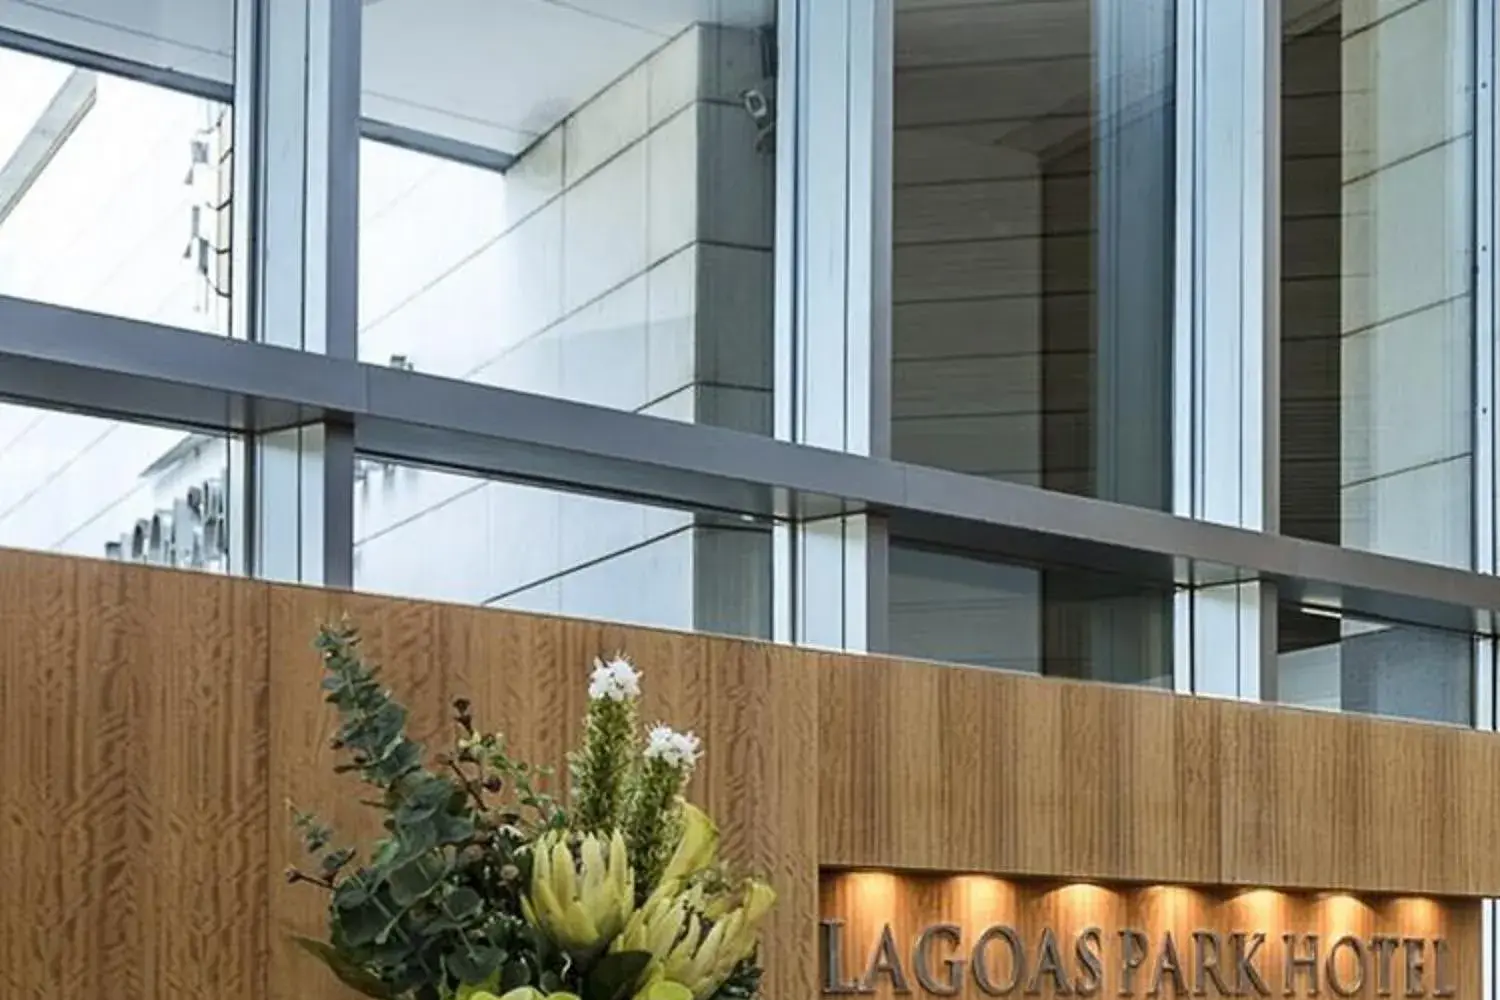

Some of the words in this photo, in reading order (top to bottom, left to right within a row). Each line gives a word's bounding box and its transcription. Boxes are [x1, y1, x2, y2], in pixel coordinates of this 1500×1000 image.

[821, 918, 1102, 997] LAGOAS
[1118, 930, 1272, 998] PARK
[1282, 933, 1456, 998] HOTEL
